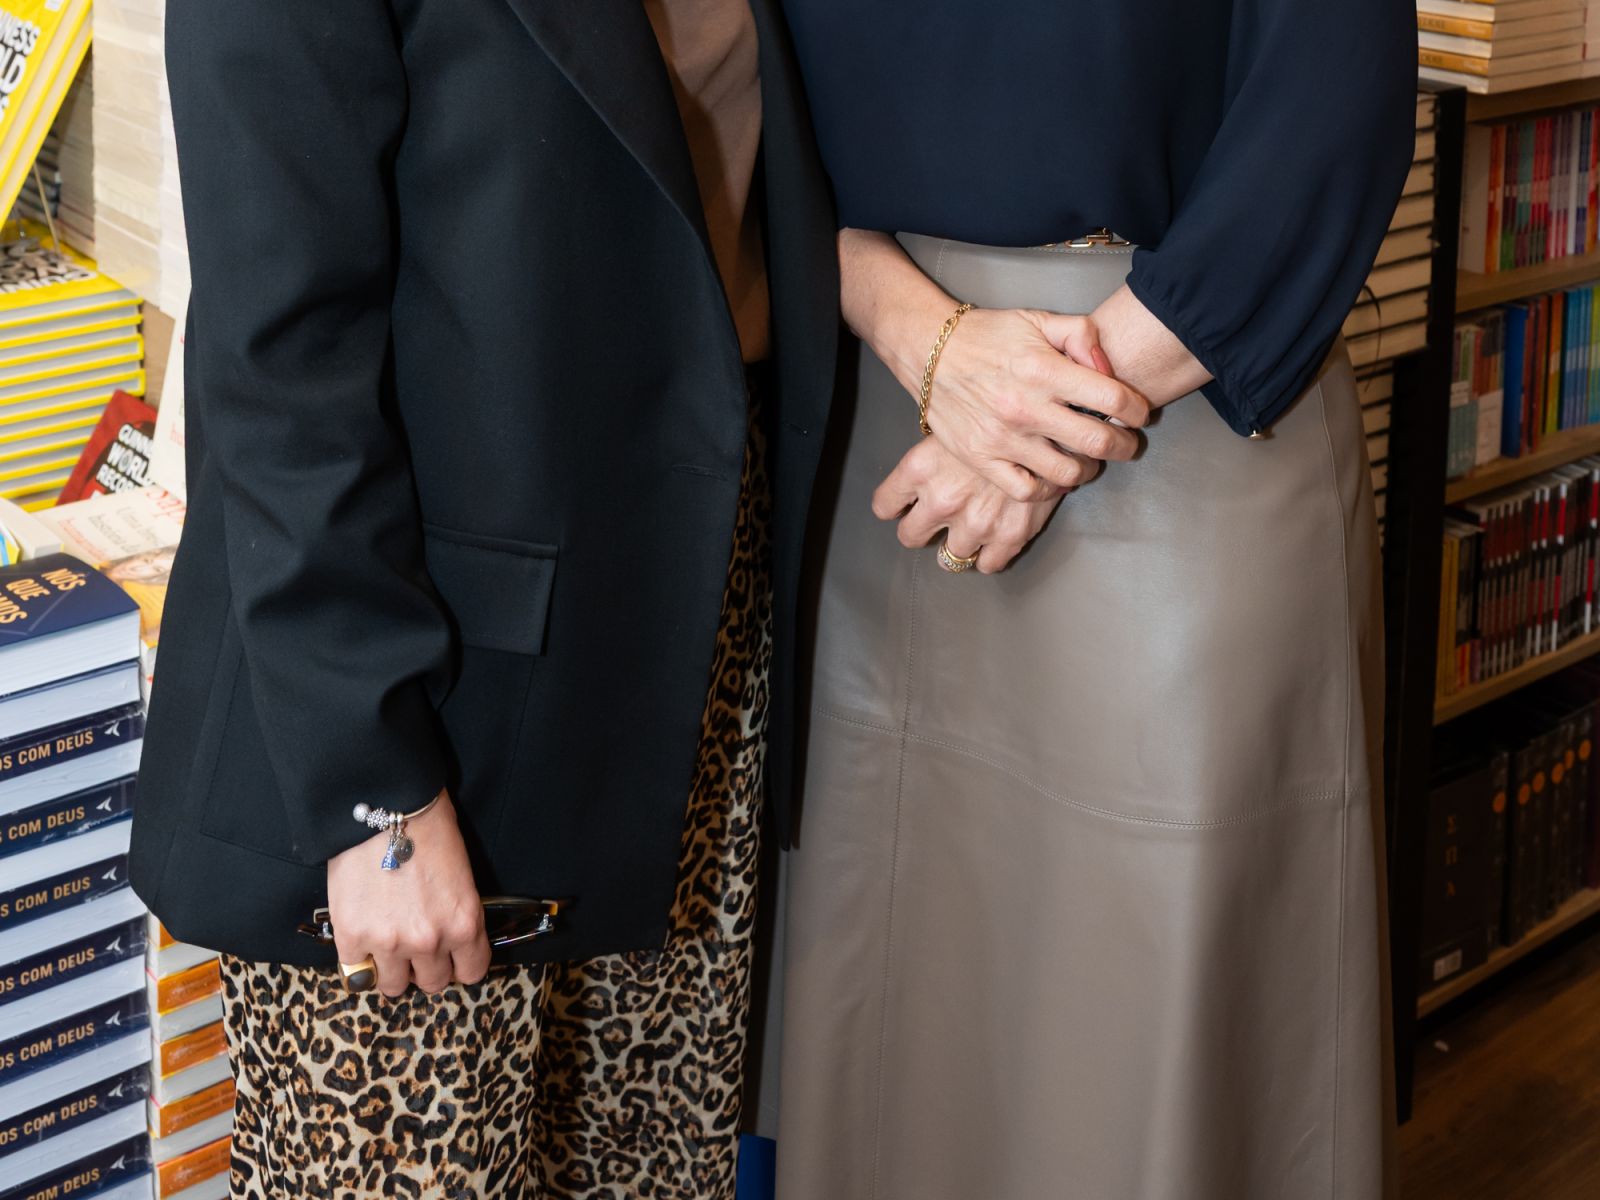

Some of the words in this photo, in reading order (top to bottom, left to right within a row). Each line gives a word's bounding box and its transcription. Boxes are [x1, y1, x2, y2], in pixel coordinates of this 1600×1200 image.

[107, 441, 155, 487] WORL
[6, 578, 51, 601] QUE
[41, 568, 86, 591] NÓS
[18, 743, 51, 765] COM
[56, 729, 95, 754] DEUS
[8, 818, 42, 840] COM
[47, 806, 86, 829] DEUS
[15, 891, 48, 912] COM
[53, 876, 91, 900] DEUS
[20, 963, 53, 985] COM
[58, 948, 96, 972] DEUS
[20, 1038, 53, 1061] COM
[57, 1022, 95, 1047] DEUS
[23, 1112, 56, 1135] COM
[60, 1095, 98, 1120] DEUS
[63, 1168, 101, 1193] DEUS
